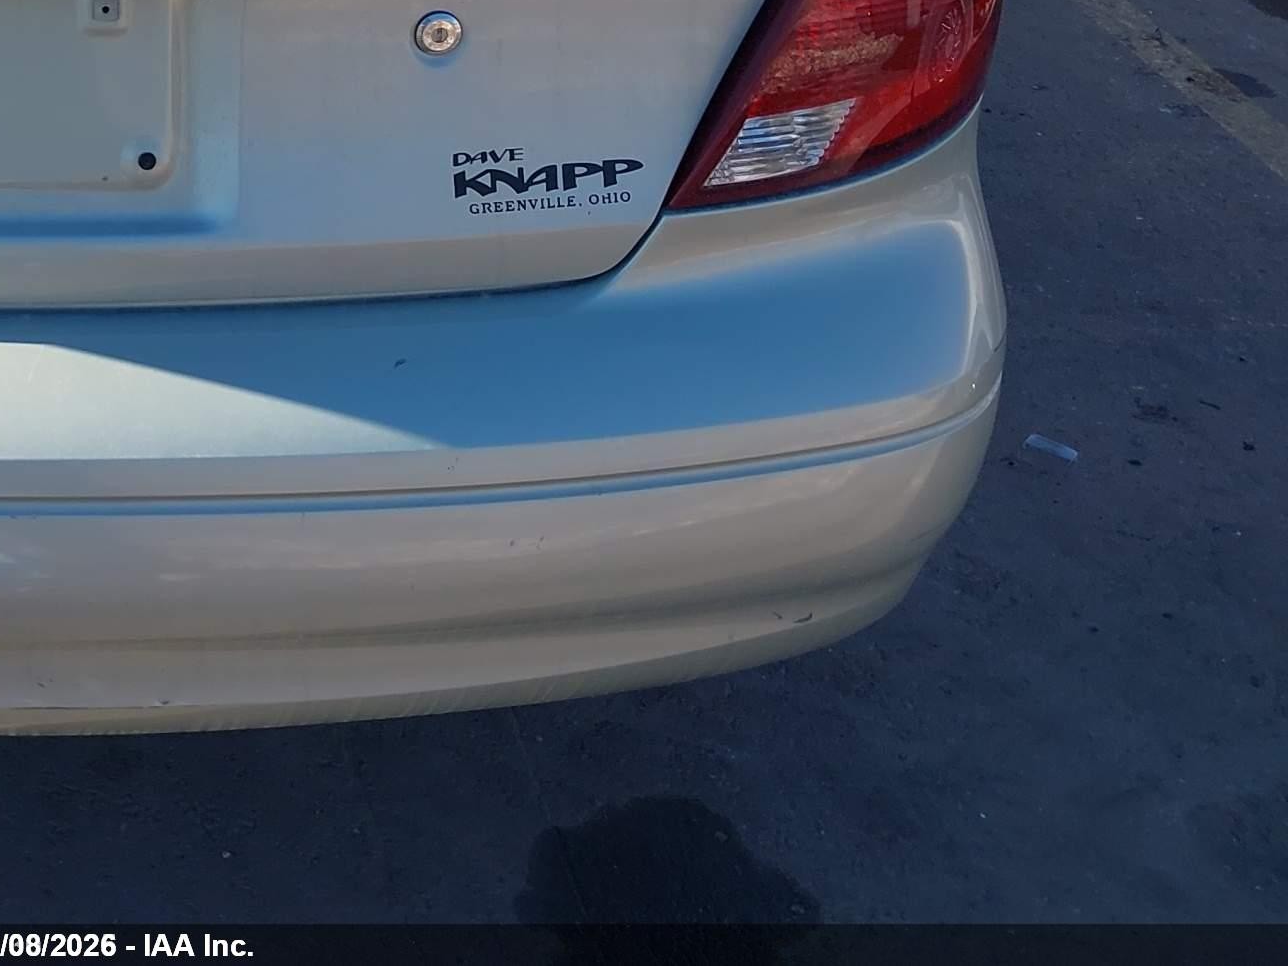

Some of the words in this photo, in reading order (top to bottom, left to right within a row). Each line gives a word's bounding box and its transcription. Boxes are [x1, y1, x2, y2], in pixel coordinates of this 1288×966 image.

[452, 147, 524, 167] DAVE
[453, 159, 644, 198] KNAPP
[588, 191, 631, 205] OHIO
